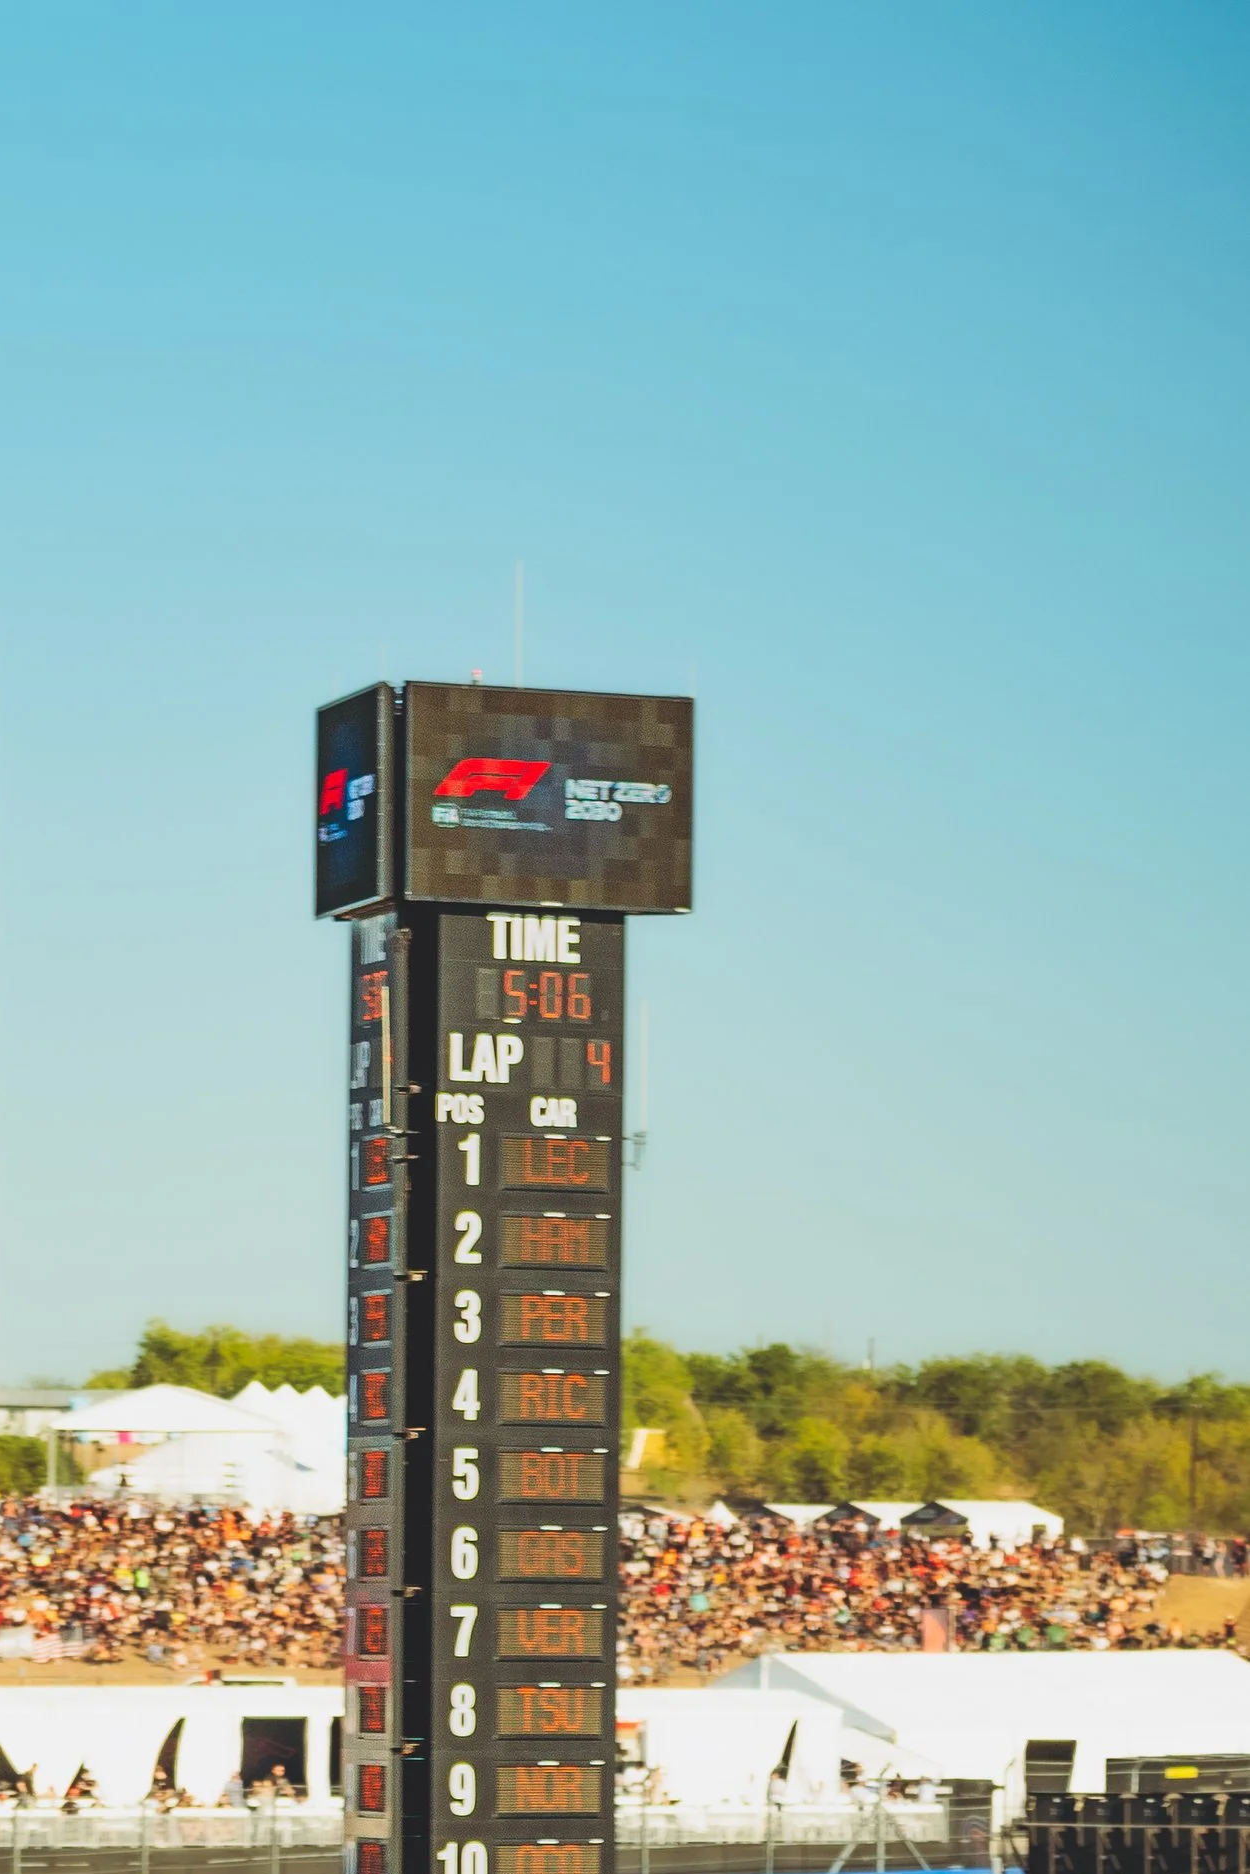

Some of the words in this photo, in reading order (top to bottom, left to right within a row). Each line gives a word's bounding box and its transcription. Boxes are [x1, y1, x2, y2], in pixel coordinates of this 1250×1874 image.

[489, 913, 581, 963] TIME
[503, 970, 591, 1020] 5:06
[449, 1032, 524, 1083] LAP
[436, 1093, 485, 1125] POS
[530, 1096, 578, 1127] CAR
[457, 1133, 481, 1186] 1
[523, 1139, 590, 1185] LEC
[454, 1210, 483, 1264] 2
[453, 1290, 482, 1344] 3
[520, 1295, 588, 1340] PER
[452, 1368, 481, 1421] 4
[519, 1373, 588, 1419] RIC
[452, 1447, 480, 1501] 5
[520, 1452, 586, 1497] BOT
[450, 1526, 479, 1580] 6
[450, 1603, 478, 1657] 7
[449, 1682, 477, 1737] 8
[516, 1686, 584, 1732] TSU
[449, 1762, 477, 1817] 9
